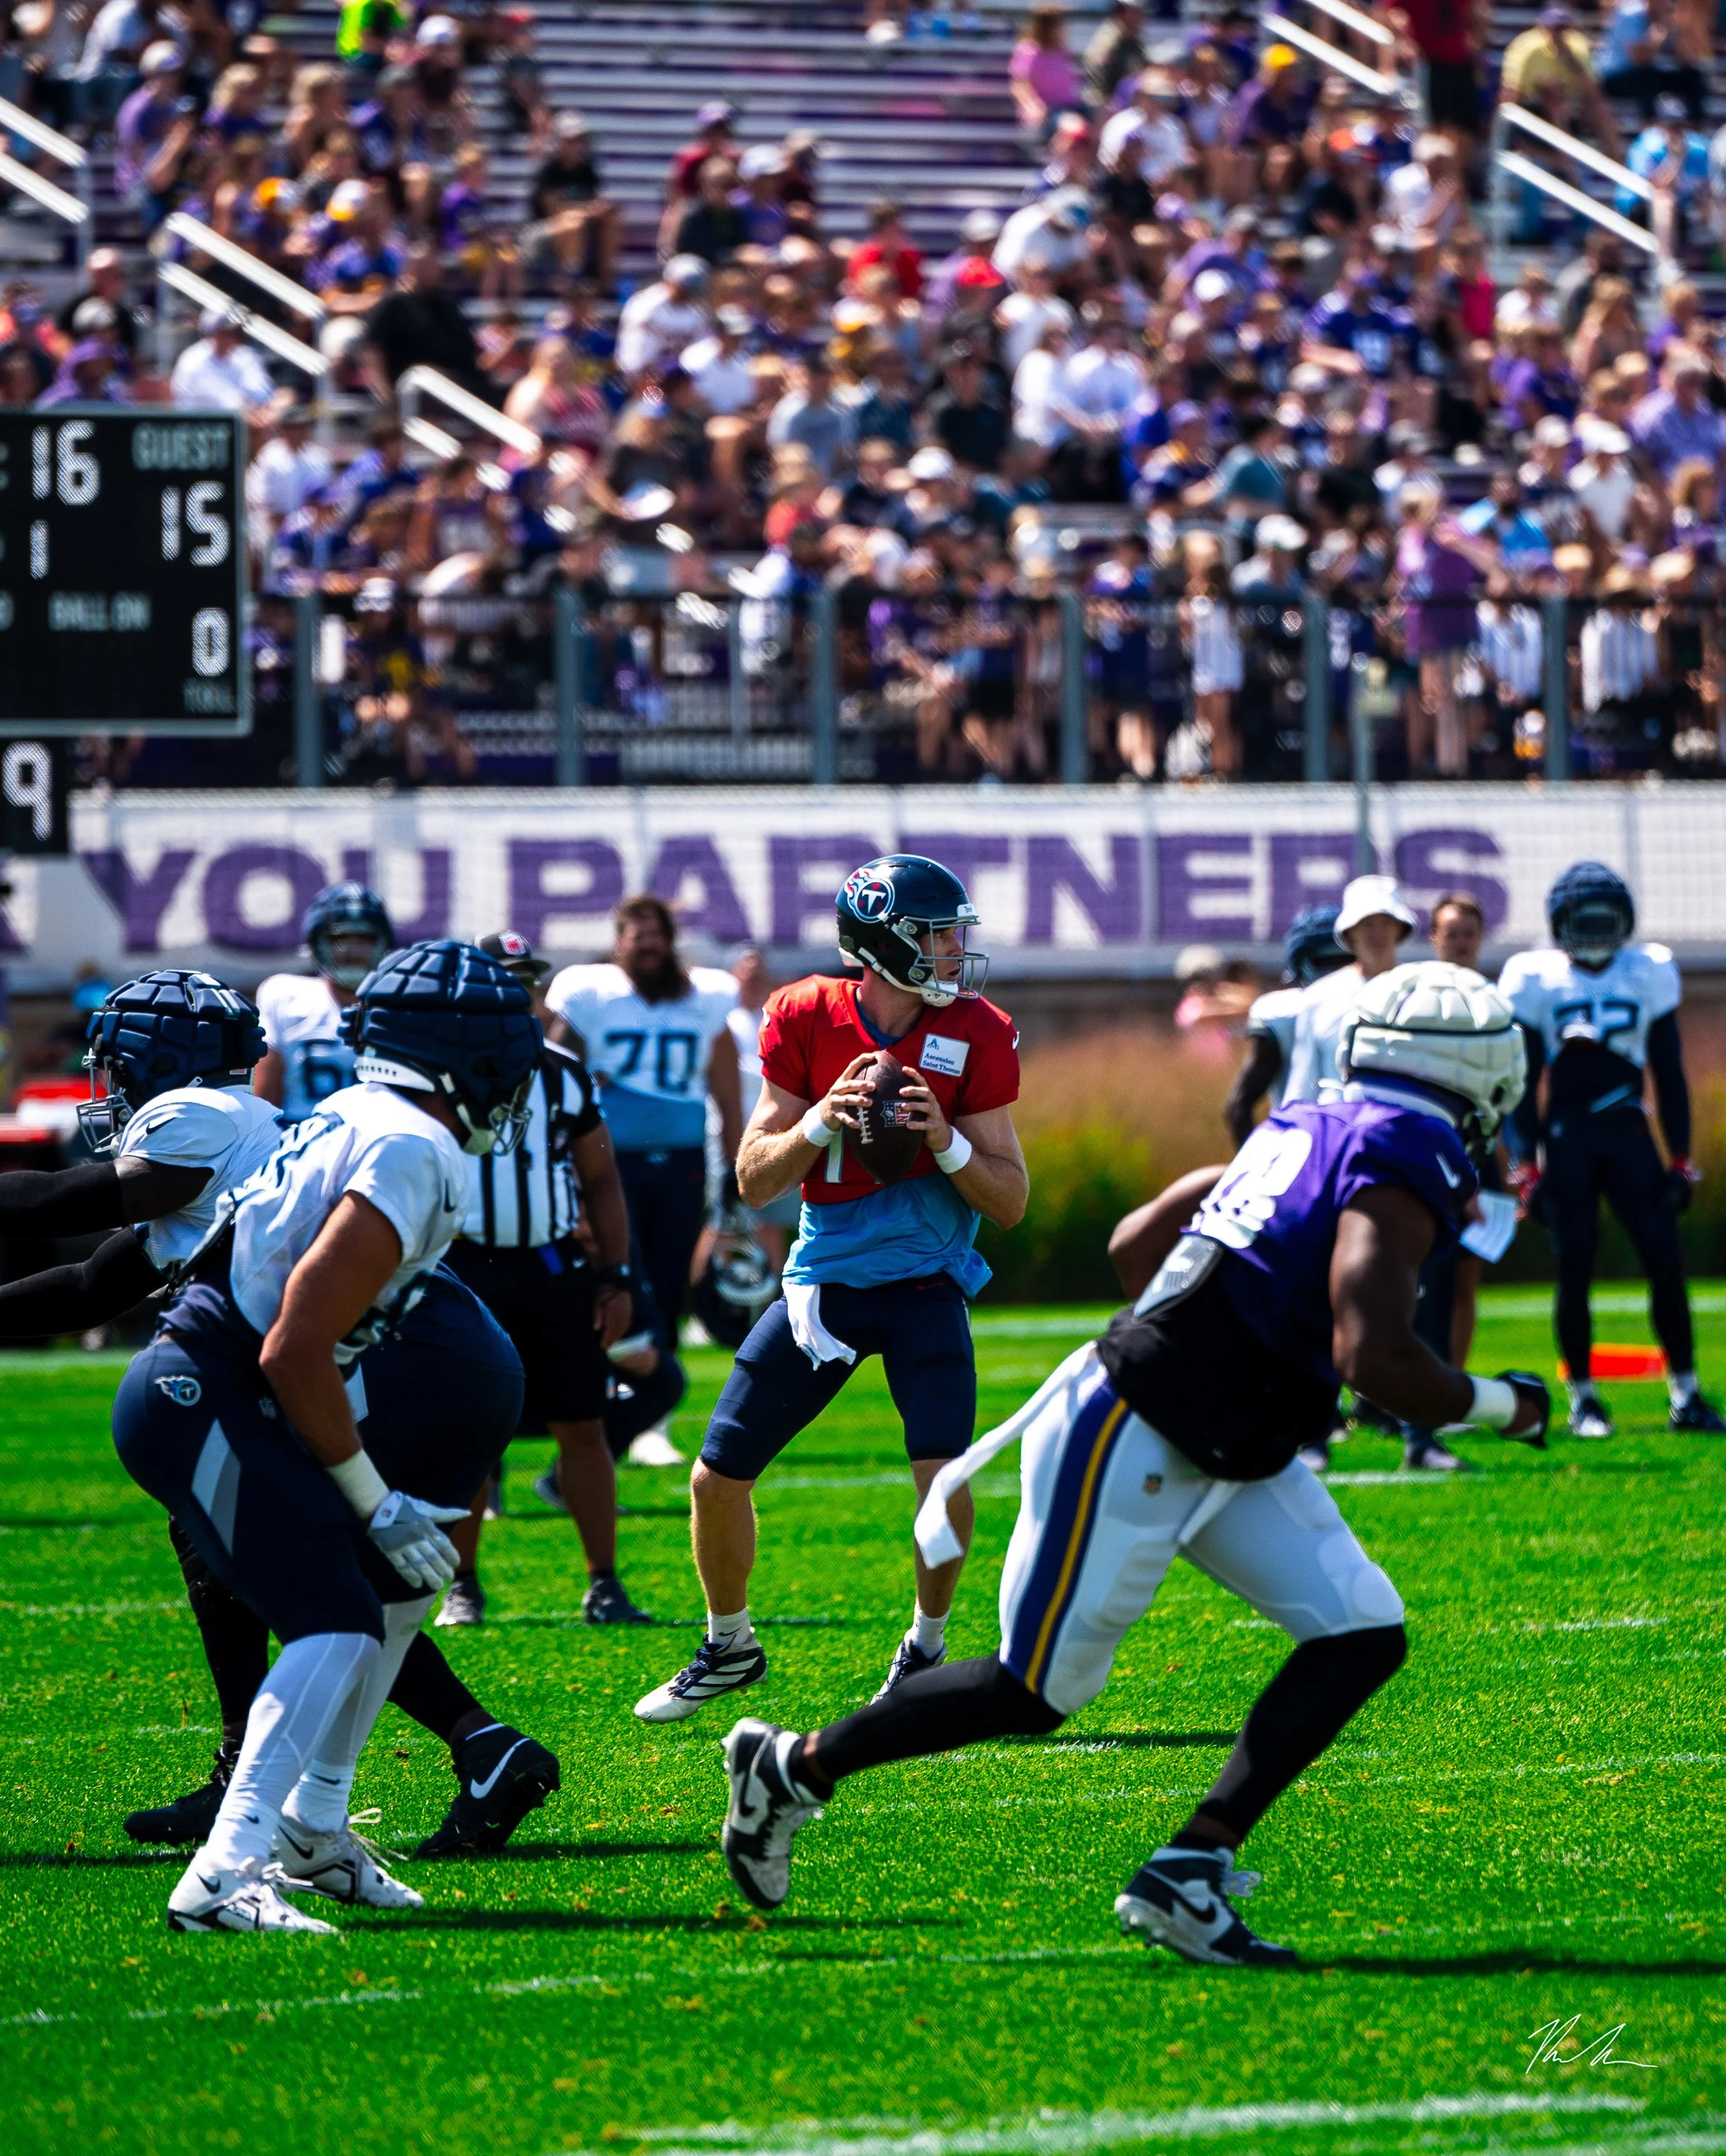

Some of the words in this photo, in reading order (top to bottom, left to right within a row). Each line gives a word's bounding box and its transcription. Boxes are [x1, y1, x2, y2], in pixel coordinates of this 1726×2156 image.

[131, 423, 230, 470] GUEST
[161, 481, 230, 567] 15
[193, 608, 230, 677] 0
[3, 741, 52, 840] 9
[82, 844, 451, 953] YOU
[605, 1029, 699, 1092] 70
[922, 1060, 938, 1069] Saint
[939, 1064, 961, 1075] Thomas
[924, 1052, 955, 1065] Ascension
